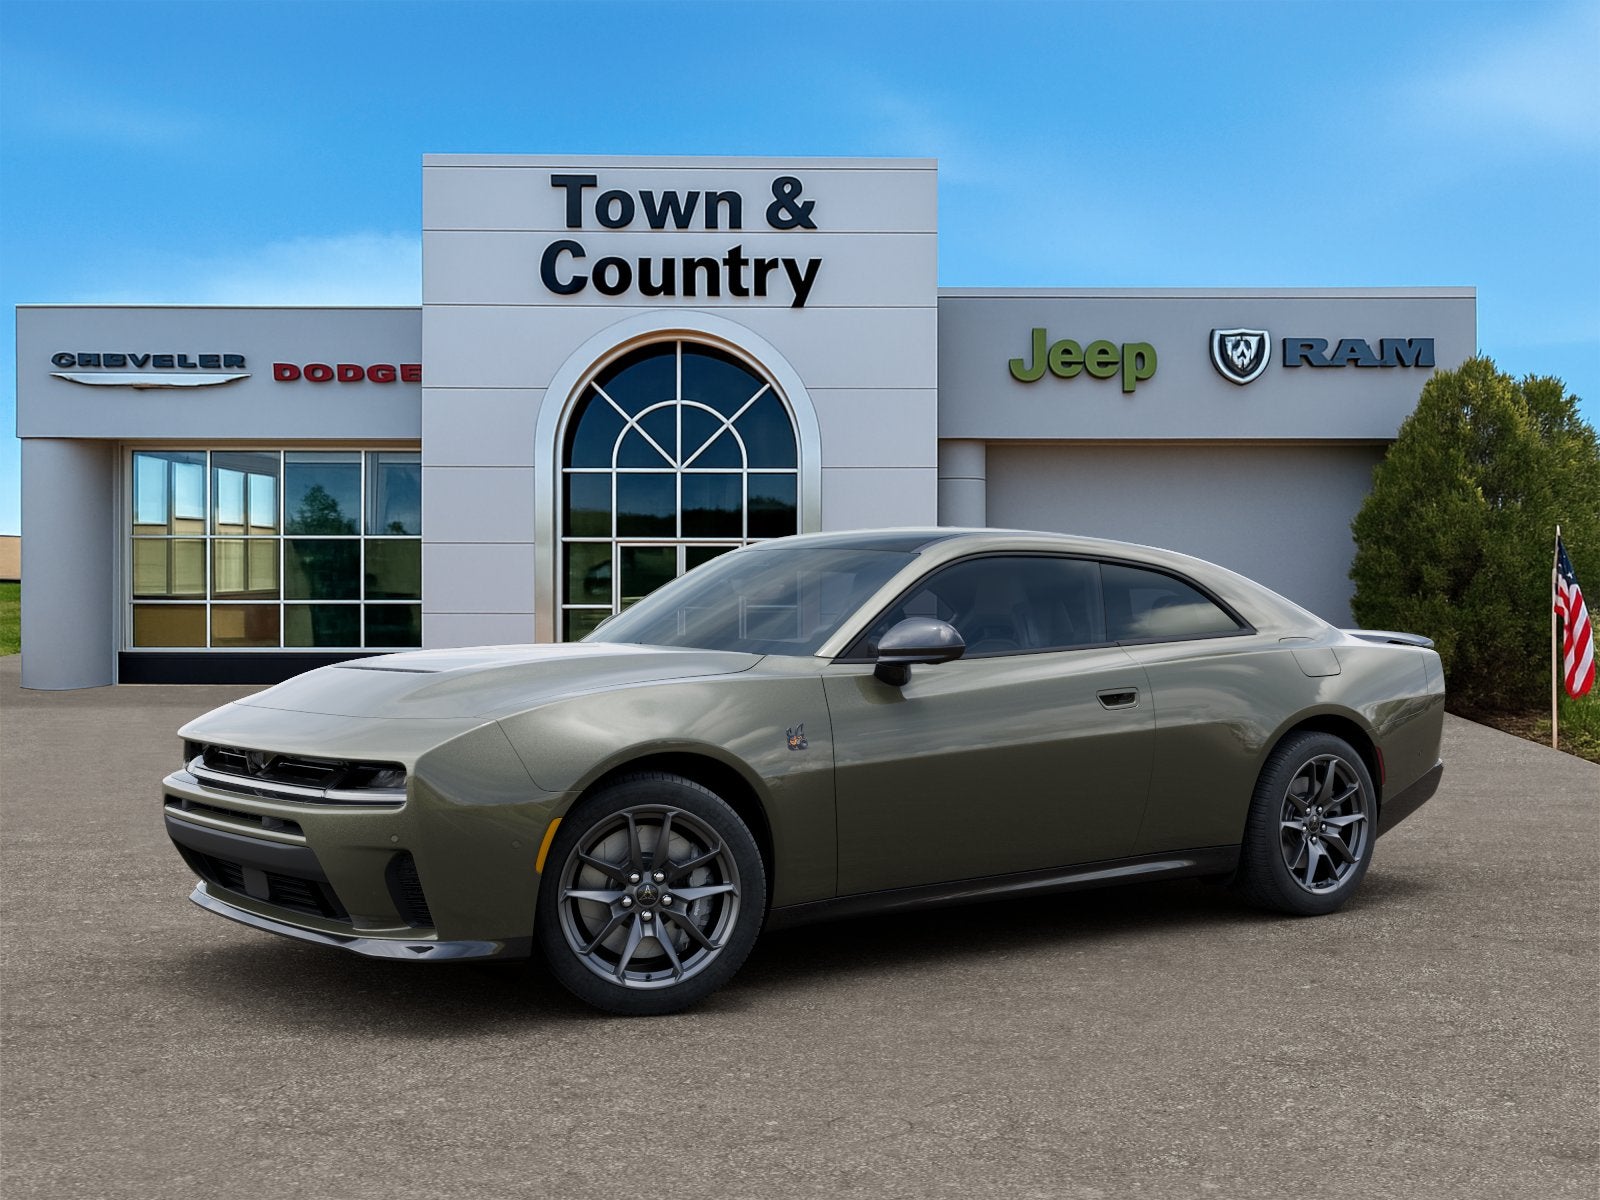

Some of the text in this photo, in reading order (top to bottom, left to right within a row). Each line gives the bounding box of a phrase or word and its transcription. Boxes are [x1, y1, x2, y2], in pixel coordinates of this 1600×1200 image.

[550, 174, 818, 230] Town &
[540, 239, 823, 308] Country
[273, 363, 422, 383] DODGE
[1009, 328, 1157, 392] Jeep
[1282, 338, 1435, 367] RAM
